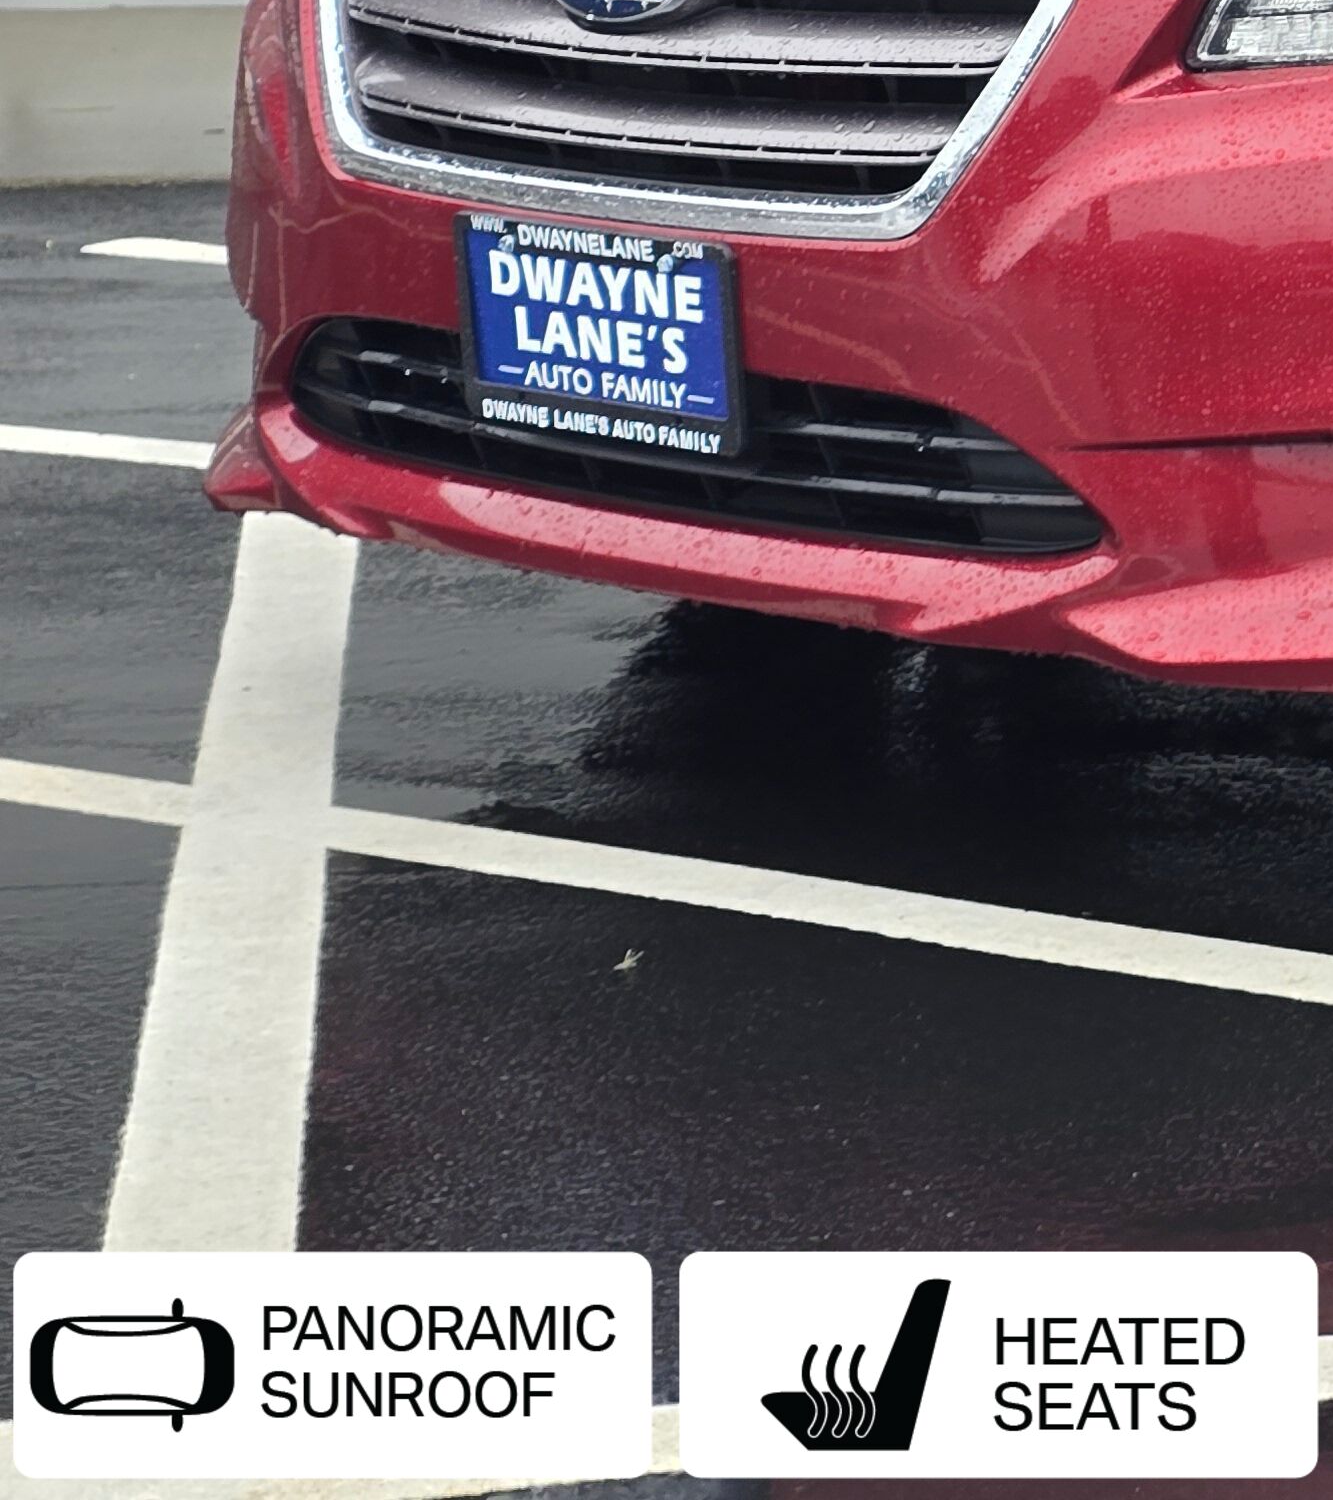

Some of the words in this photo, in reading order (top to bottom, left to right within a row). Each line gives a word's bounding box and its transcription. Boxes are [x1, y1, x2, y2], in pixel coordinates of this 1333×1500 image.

[516, 223, 655, 263] DWAYNELANE
[488, 250, 704, 324] DWAYNE
[514, 306, 687, 374] LANE'S
[524, 361, 593, 396] AUTO
[601, 371, 687, 409] FAMILY
[482, 398, 549, 428] DWAYNE
[553, 408, 609, 436] LANE'S
[612, 418, 656, 444] AUTO
[658, 425, 721, 454] FAMILY
